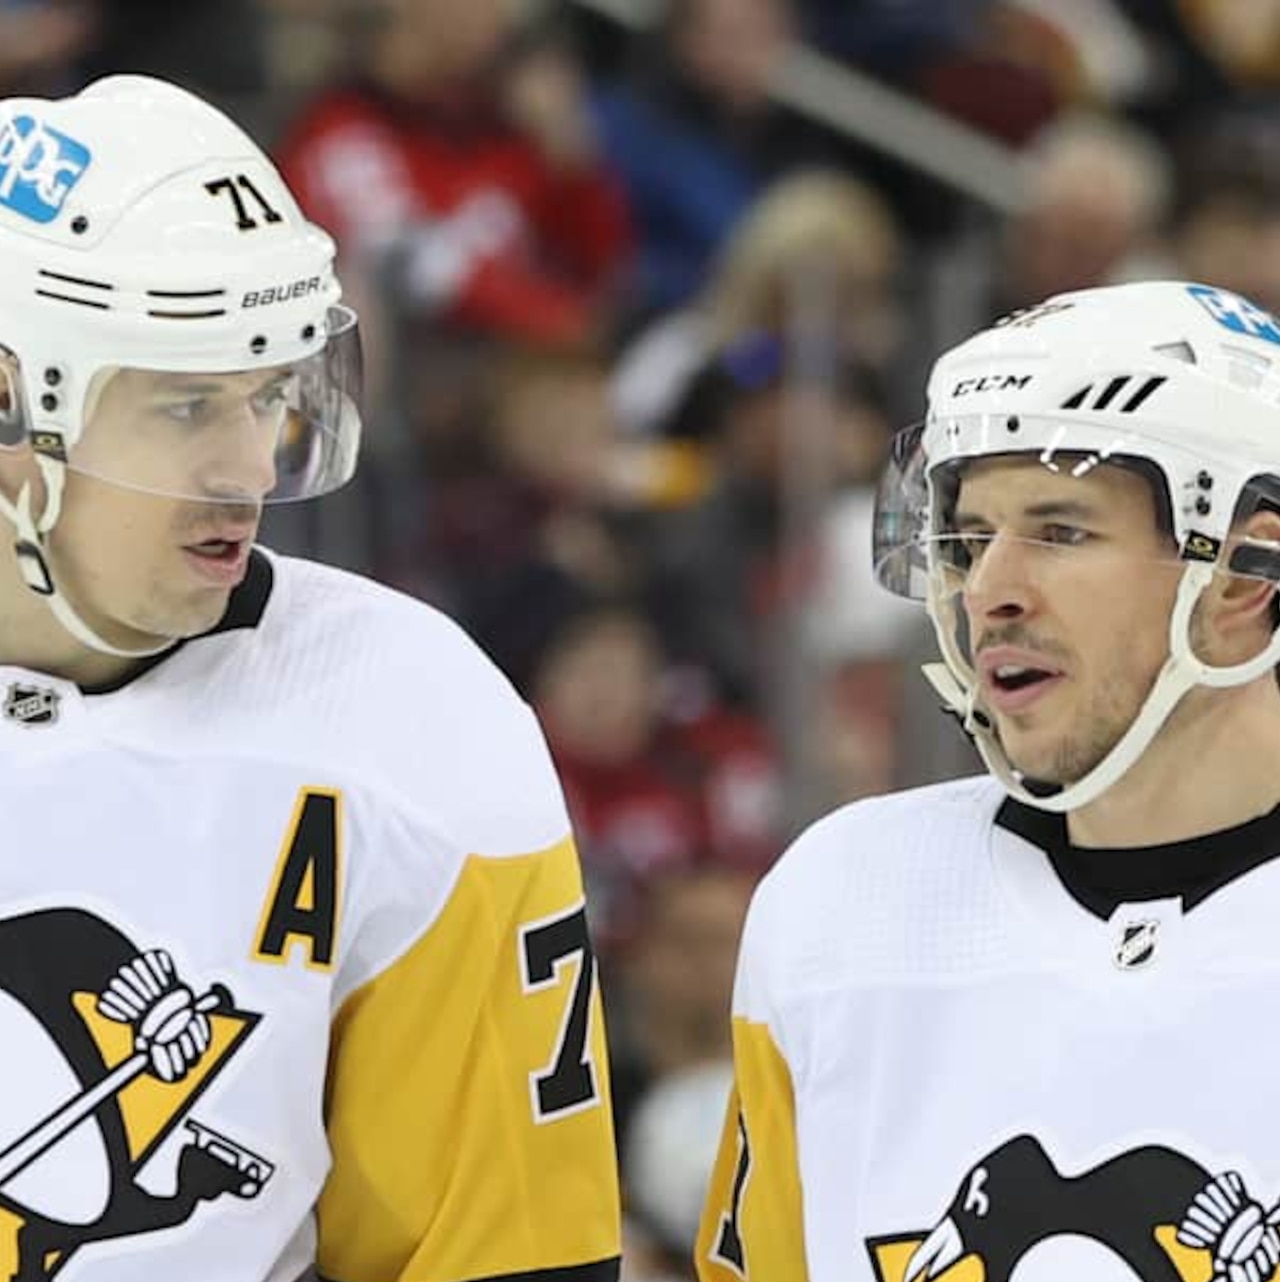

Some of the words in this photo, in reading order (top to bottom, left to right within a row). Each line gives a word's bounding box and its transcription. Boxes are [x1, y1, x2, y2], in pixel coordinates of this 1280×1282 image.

[204, 174, 283, 231] 71
[952, 375, 1033, 399] CCM
[250, 785, 343, 973] A
